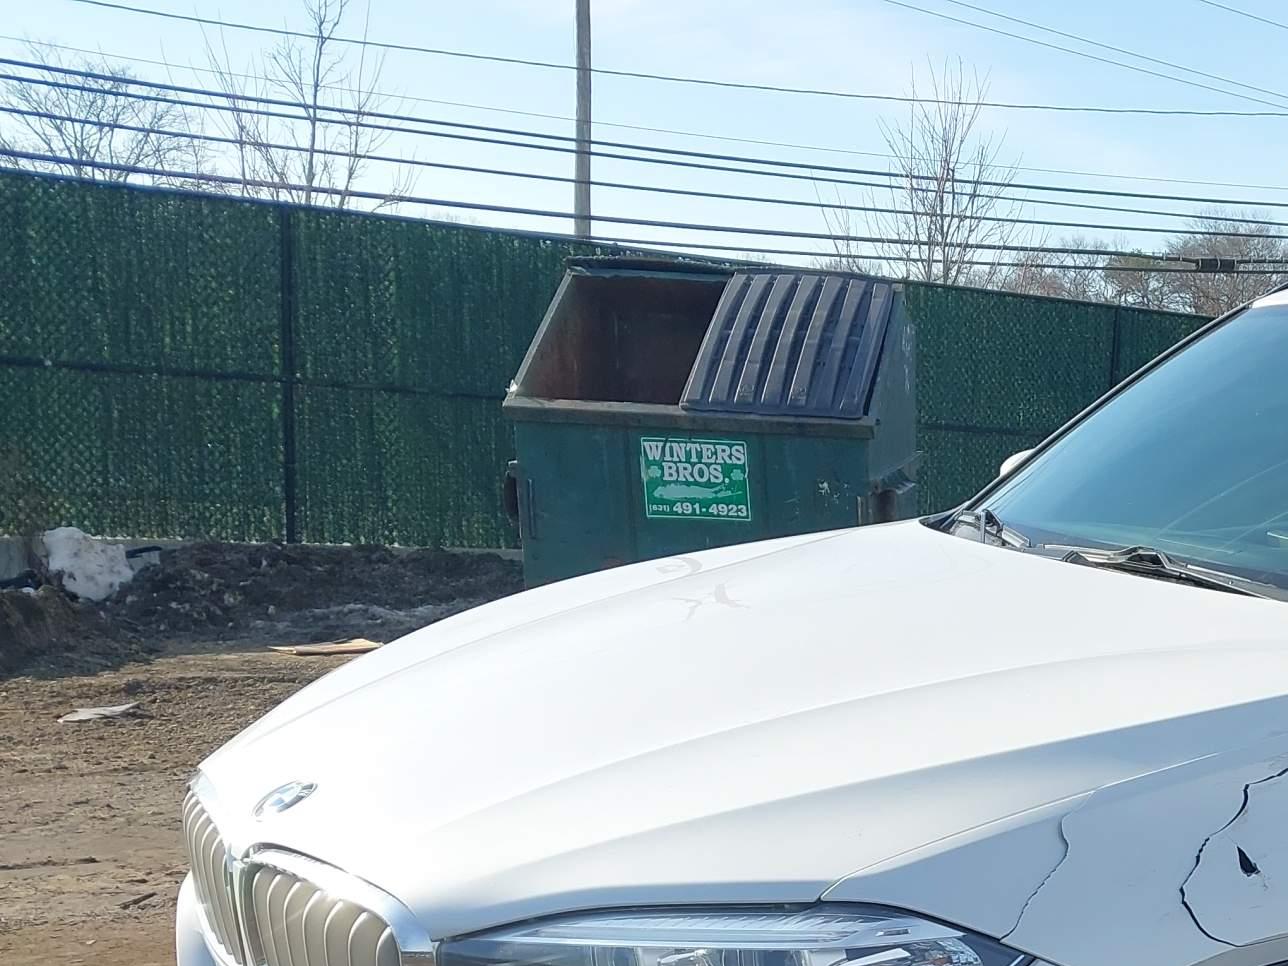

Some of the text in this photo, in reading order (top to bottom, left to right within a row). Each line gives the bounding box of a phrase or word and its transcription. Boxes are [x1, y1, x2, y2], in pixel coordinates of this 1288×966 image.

[643, 441, 745, 464] WINTERS
[662, 462, 730, 484] BROS.
[673, 501, 747, 517] 491-4923
